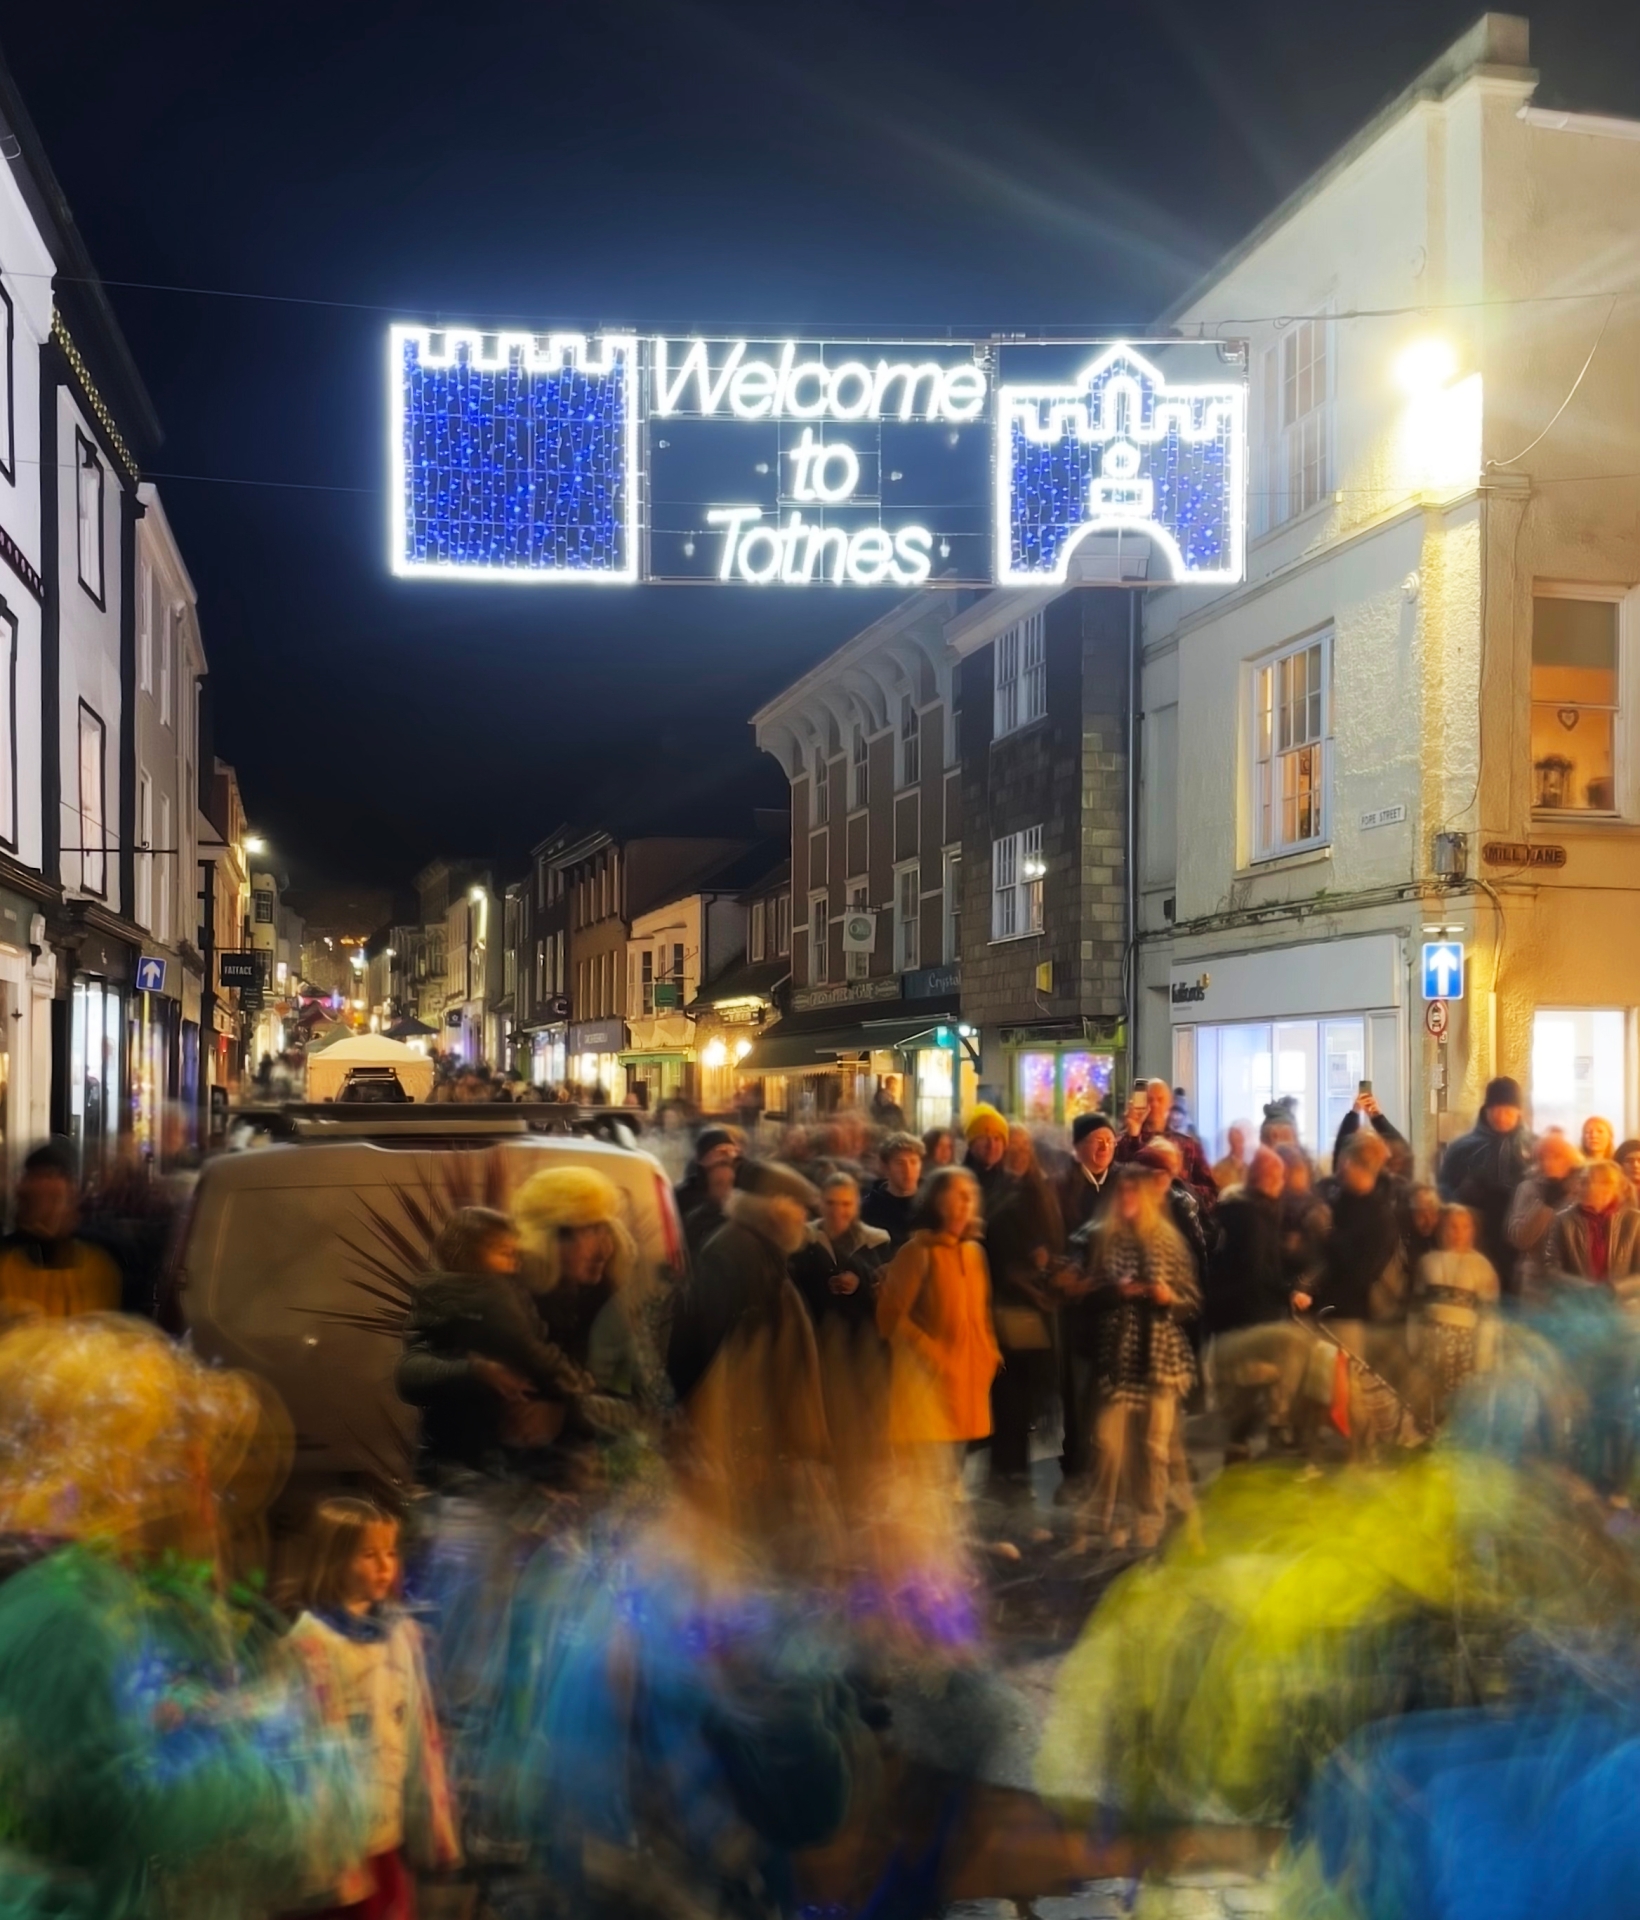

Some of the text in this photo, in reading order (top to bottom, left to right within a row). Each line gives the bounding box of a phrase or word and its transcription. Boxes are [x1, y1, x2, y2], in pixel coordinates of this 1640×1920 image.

[654, 337, 988, 421] Welcome
[790, 426, 860, 502] to
[706, 506, 933, 585] Totnes
[1379, 807, 1402, 822] STREET
[1485, 847, 1563, 863] MILL LANE
